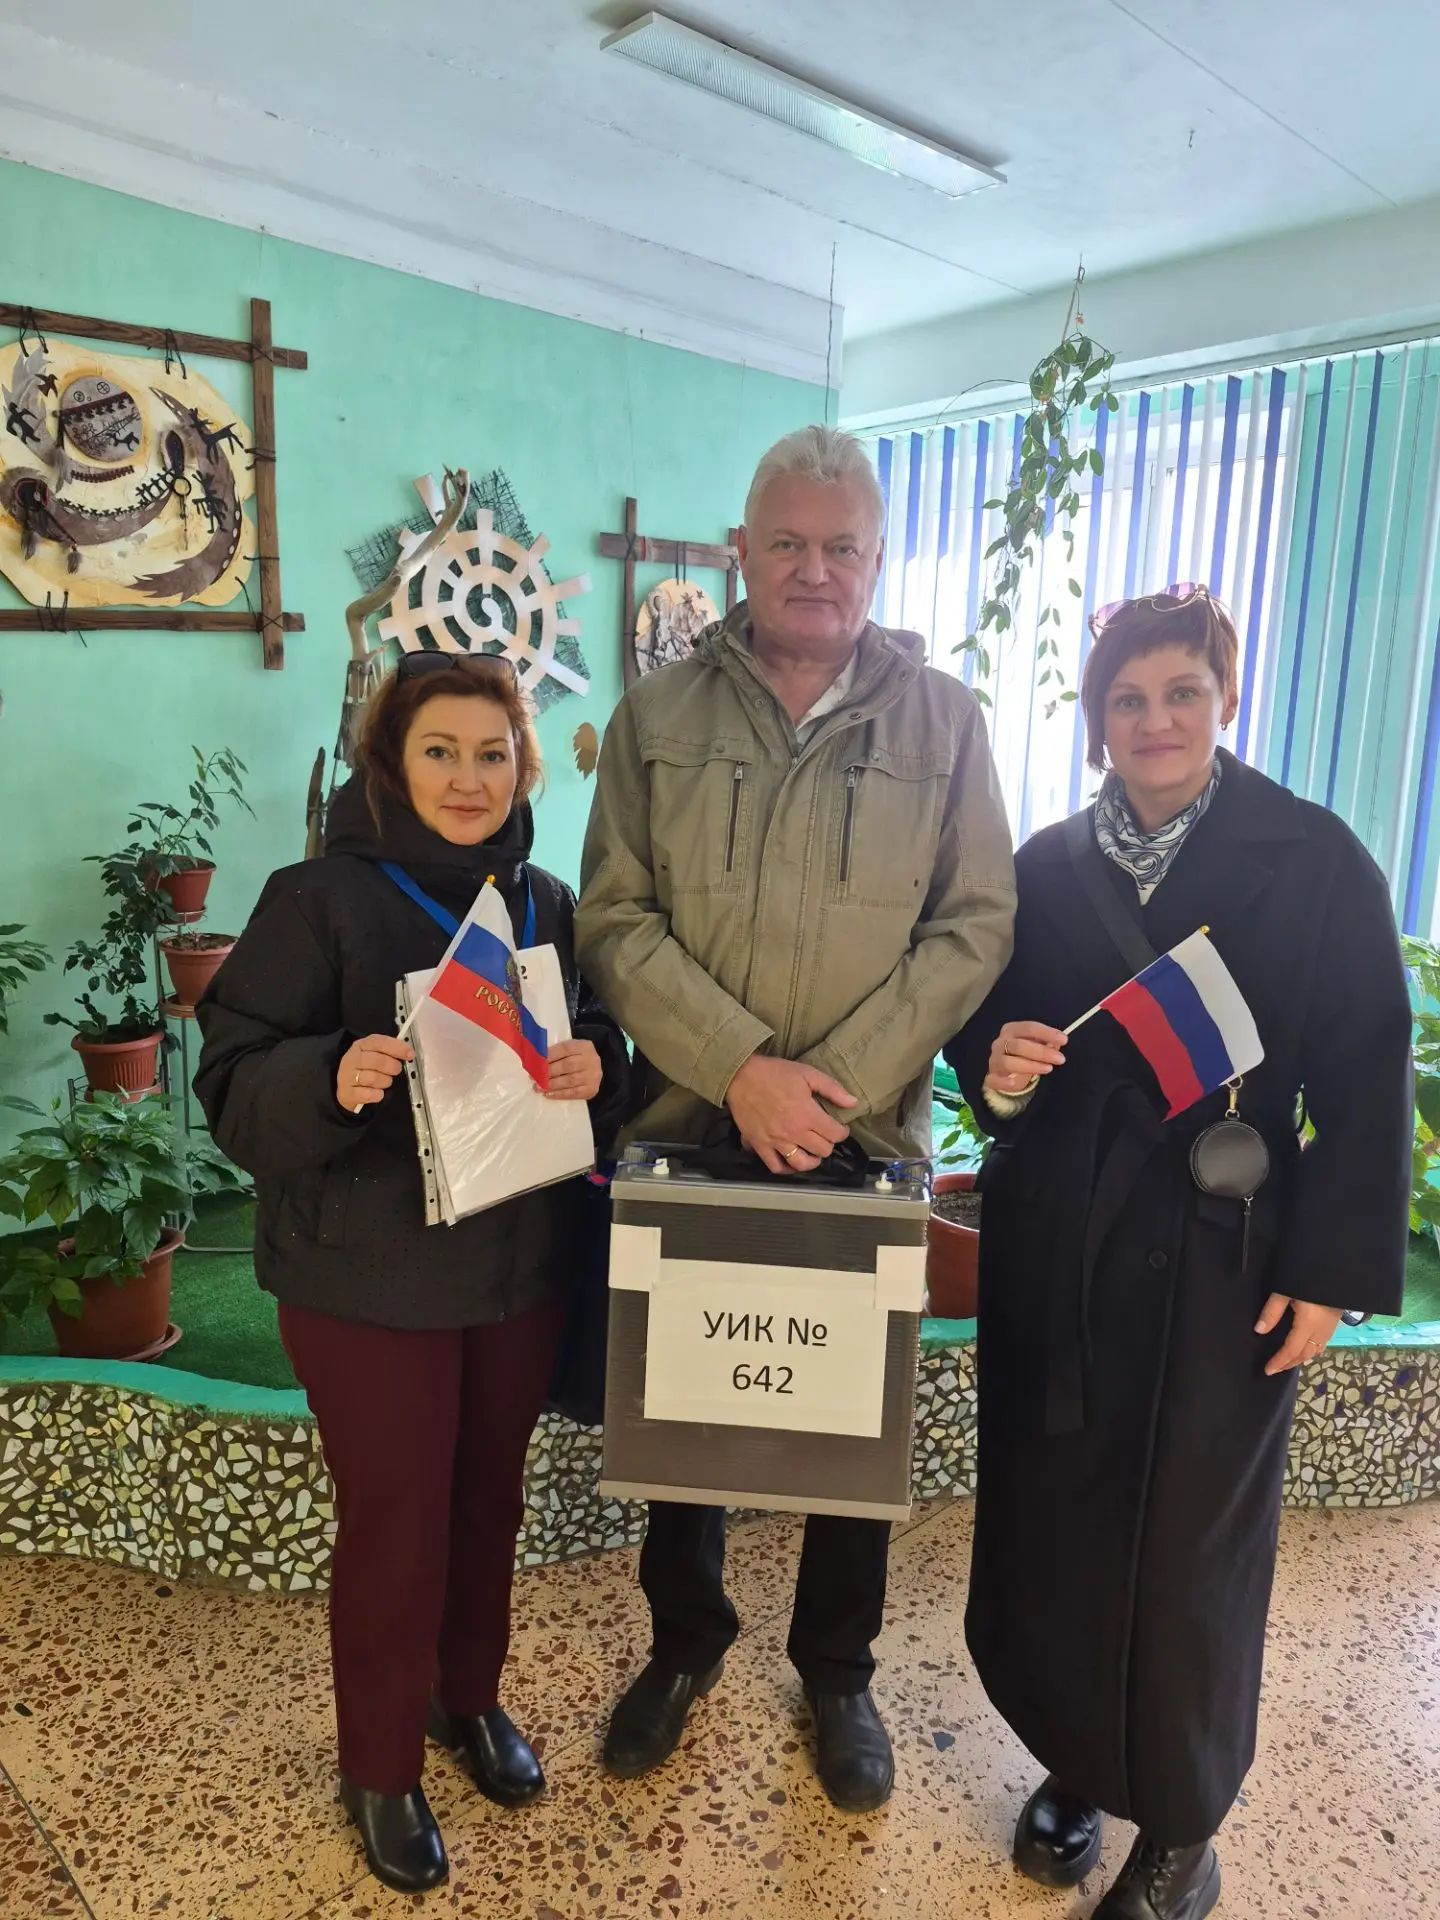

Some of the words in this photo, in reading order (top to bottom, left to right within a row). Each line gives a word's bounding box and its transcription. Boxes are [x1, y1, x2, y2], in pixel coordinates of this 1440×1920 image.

[703, 1310, 774, 1343] УИК
[787, 1317, 829, 1347] №
[732, 1363, 795, 1394] 642
